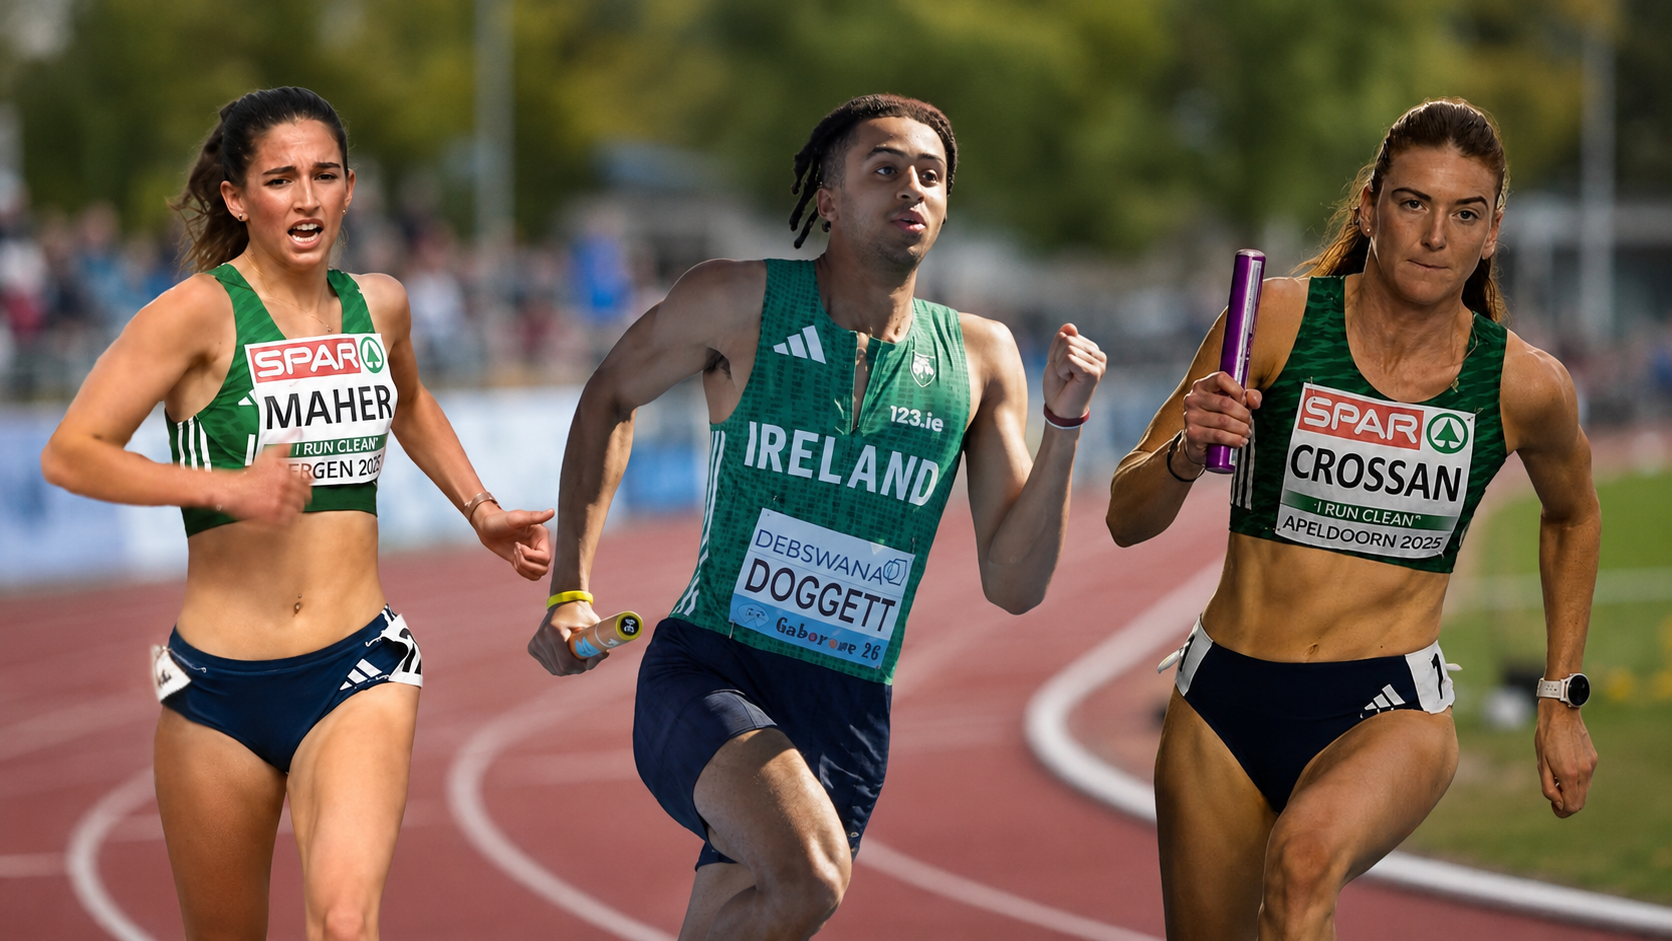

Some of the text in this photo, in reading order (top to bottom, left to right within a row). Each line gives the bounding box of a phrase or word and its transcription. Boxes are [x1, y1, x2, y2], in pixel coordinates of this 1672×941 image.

[254, 342, 359, 378] SPAR
[264, 385, 392, 429] MAHER
[890, 405, 944, 432] 123.ie
[1303, 395, 1418, 444] SPAR
[288, 459, 353, 480] ERGEN
[303, 441, 337, 455] RUN
[744, 421, 939, 506] IRELAND
[1290, 444, 1462, 502] CROSSAN
[1282, 515, 1443, 550] APELDOORN 2025
[1324, 502, 1359, 520] RUN
[755, 529, 883, 585] DEBSWANA
[744, 558, 897, 632] DOGGETT
[776, 616, 881, 661] Gaborone 26
[1430, 652, 1444, 700] 1
